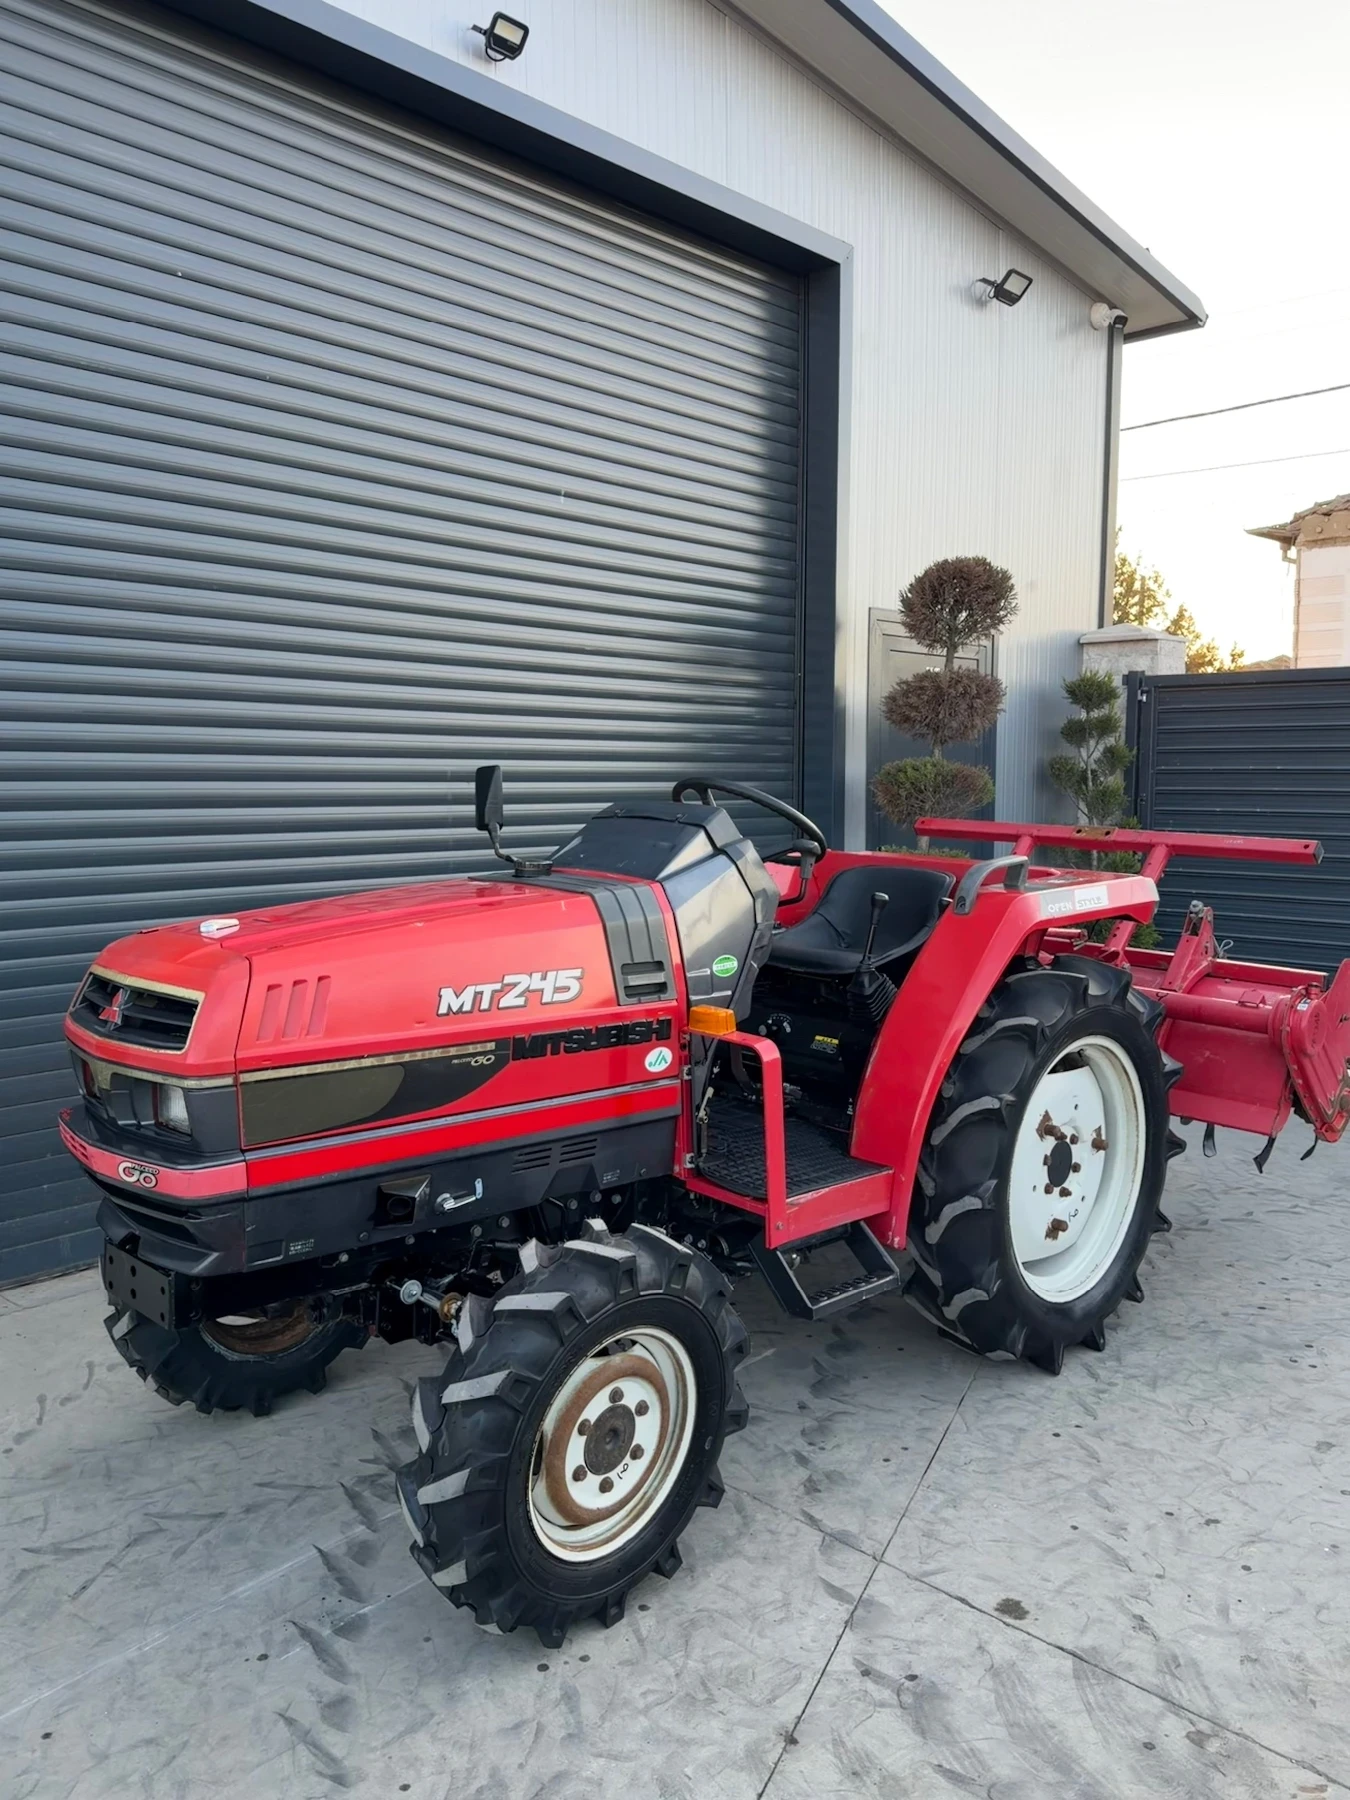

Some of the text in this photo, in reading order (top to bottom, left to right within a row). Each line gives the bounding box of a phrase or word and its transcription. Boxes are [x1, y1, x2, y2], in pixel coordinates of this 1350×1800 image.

[1048, 901, 1073, 913] OPEN
[437, 968, 583, 1016] MT245
[512, 1017, 671, 1060] MITSUBISHI
[470, 1054, 496, 1067] GO
[118, 1161, 159, 1188] GO
